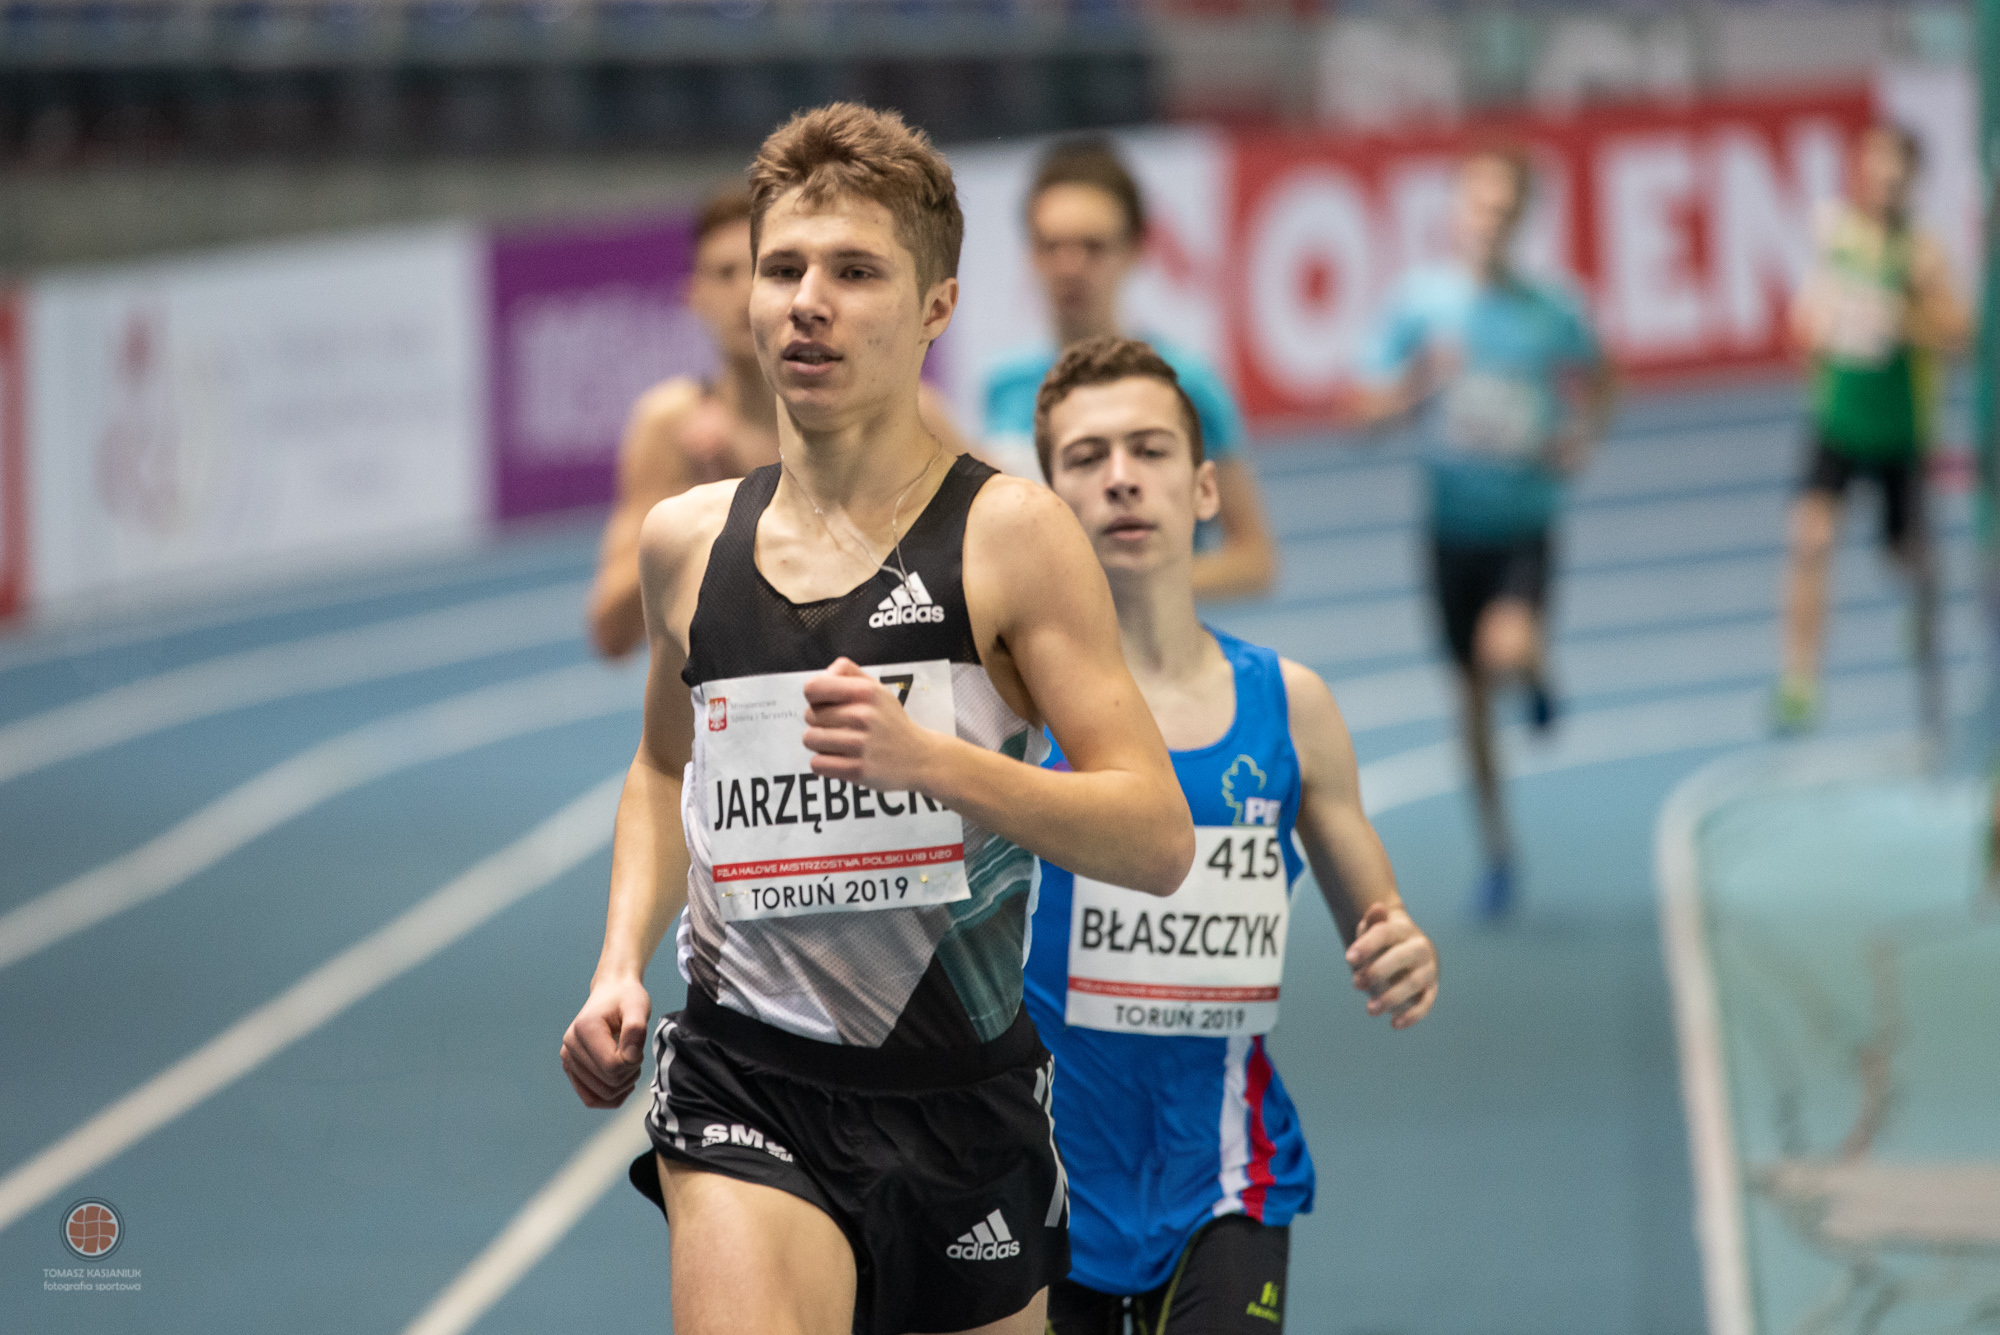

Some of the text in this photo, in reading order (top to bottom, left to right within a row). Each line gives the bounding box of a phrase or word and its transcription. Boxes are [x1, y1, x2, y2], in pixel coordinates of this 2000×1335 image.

[868, 603, 945, 628] adidas
[714, 771, 950, 833] JARZĘBEC
[739, 864, 777, 875] HALOWE
[779, 856, 860, 871] MISTRZOSTWA
[862, 854, 903, 866] POLSKI
[905, 851, 927, 861] U18
[1207, 837, 1280, 879] 415
[751, 876, 909, 910] TORUŃ 2019
[1081, 908, 1280, 956] BŁASZCZYK
[1115, 1002, 1246, 1030] TORUŃ 2019
[946, 1241, 1020, 1260] adidas
